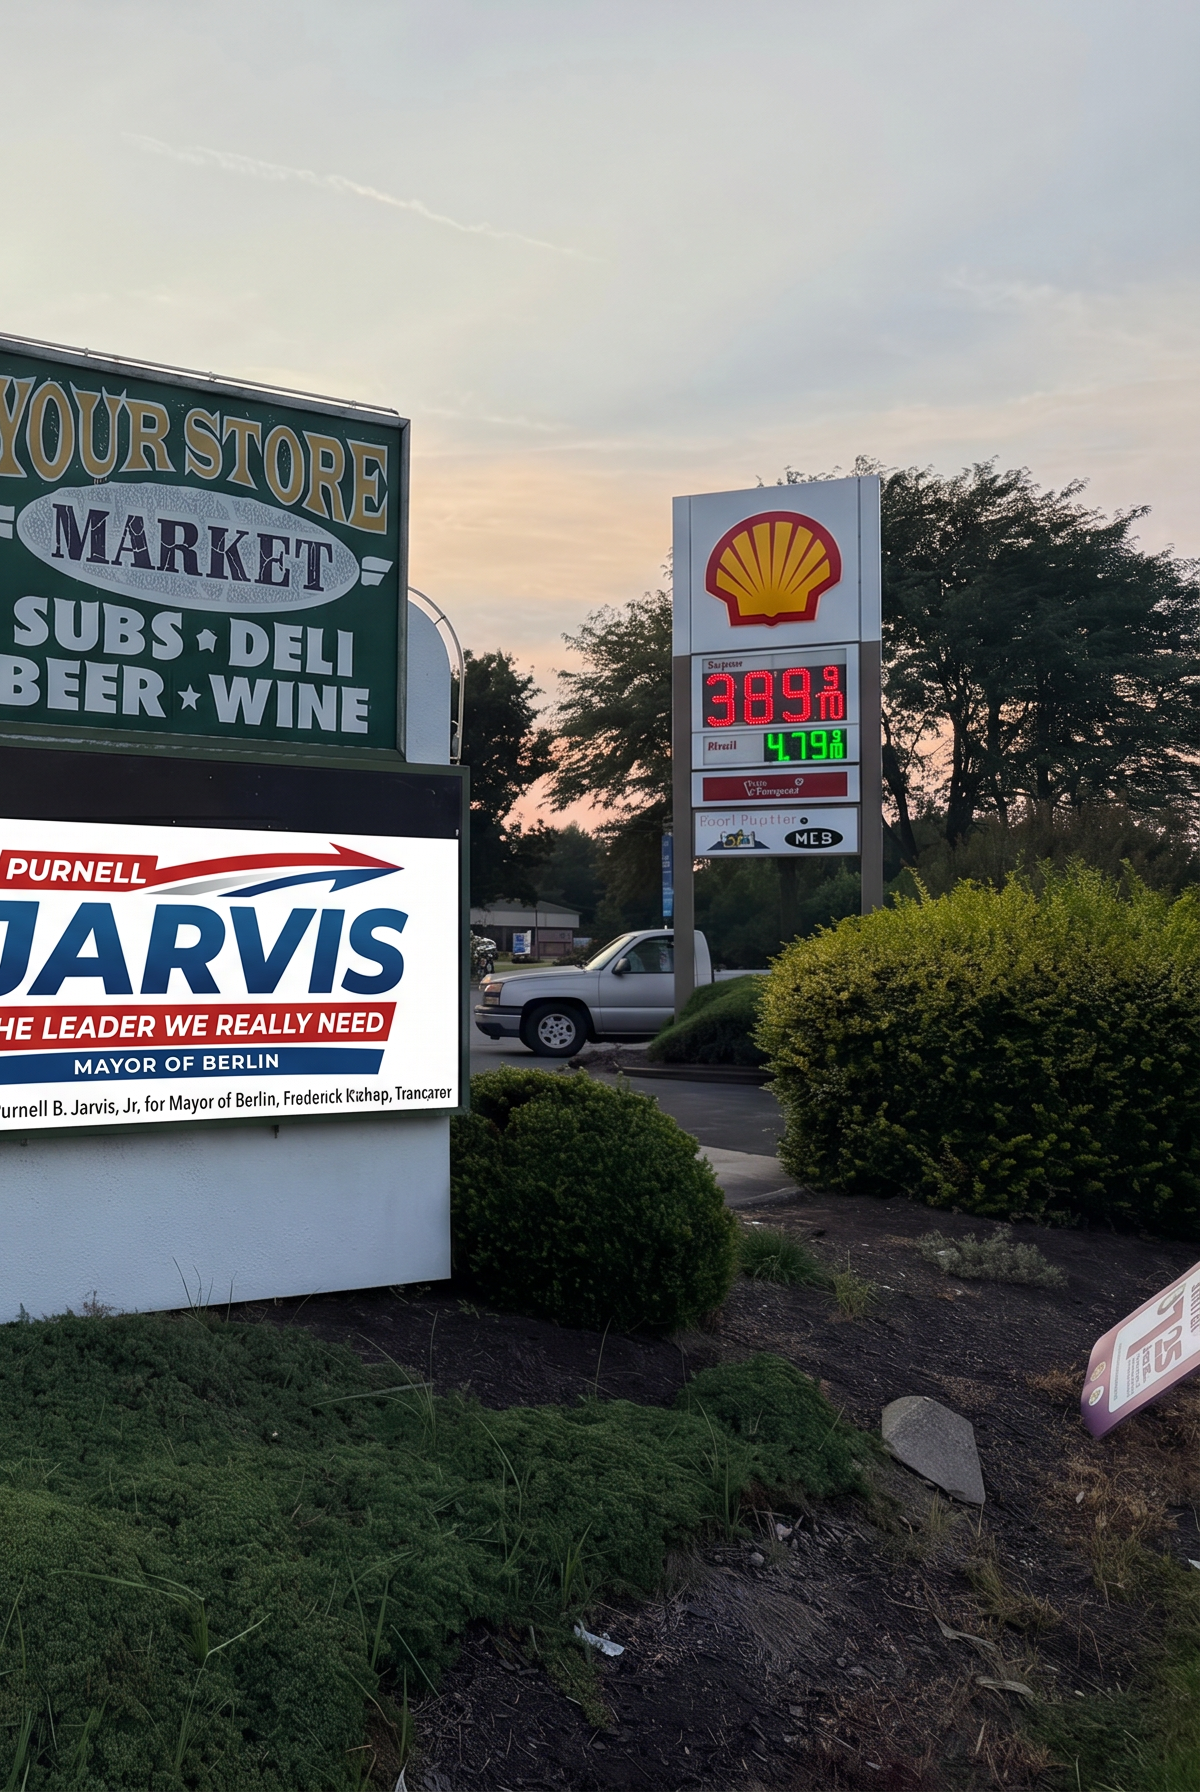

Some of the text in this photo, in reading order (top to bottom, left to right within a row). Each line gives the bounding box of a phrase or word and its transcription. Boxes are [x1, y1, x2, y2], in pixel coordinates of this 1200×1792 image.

[184, 408, 388, 535] STORE
[51, 503, 333, 592] MARKET
[13, 595, 354, 678] SUBS DELI
[208, 673, 370, 734] WINE
[6, 857, 147, 884] PURNELL
[41, 1015, 156, 1040] LEADER
[164, 1014, 209, 1037] WE
[215, 1012, 313, 1036] REALLY
[317, 1011, 384, 1034] NEED
[74, 1053, 279, 1075] MAYOR OF BERLIN
[53, 1100, 68, 1117] B.
[71, 1099, 119, 1117] Jarvis,
[122, 1097, 141, 1115] Jr,
[144, 1095, 166, 1112] for
[169, 1095, 215, 1115] Mayor
[217, 1091, 232, 1109] of
[236, 1090, 280, 1109] Berlin,
[284, 1088, 343, 1106] Frederick
